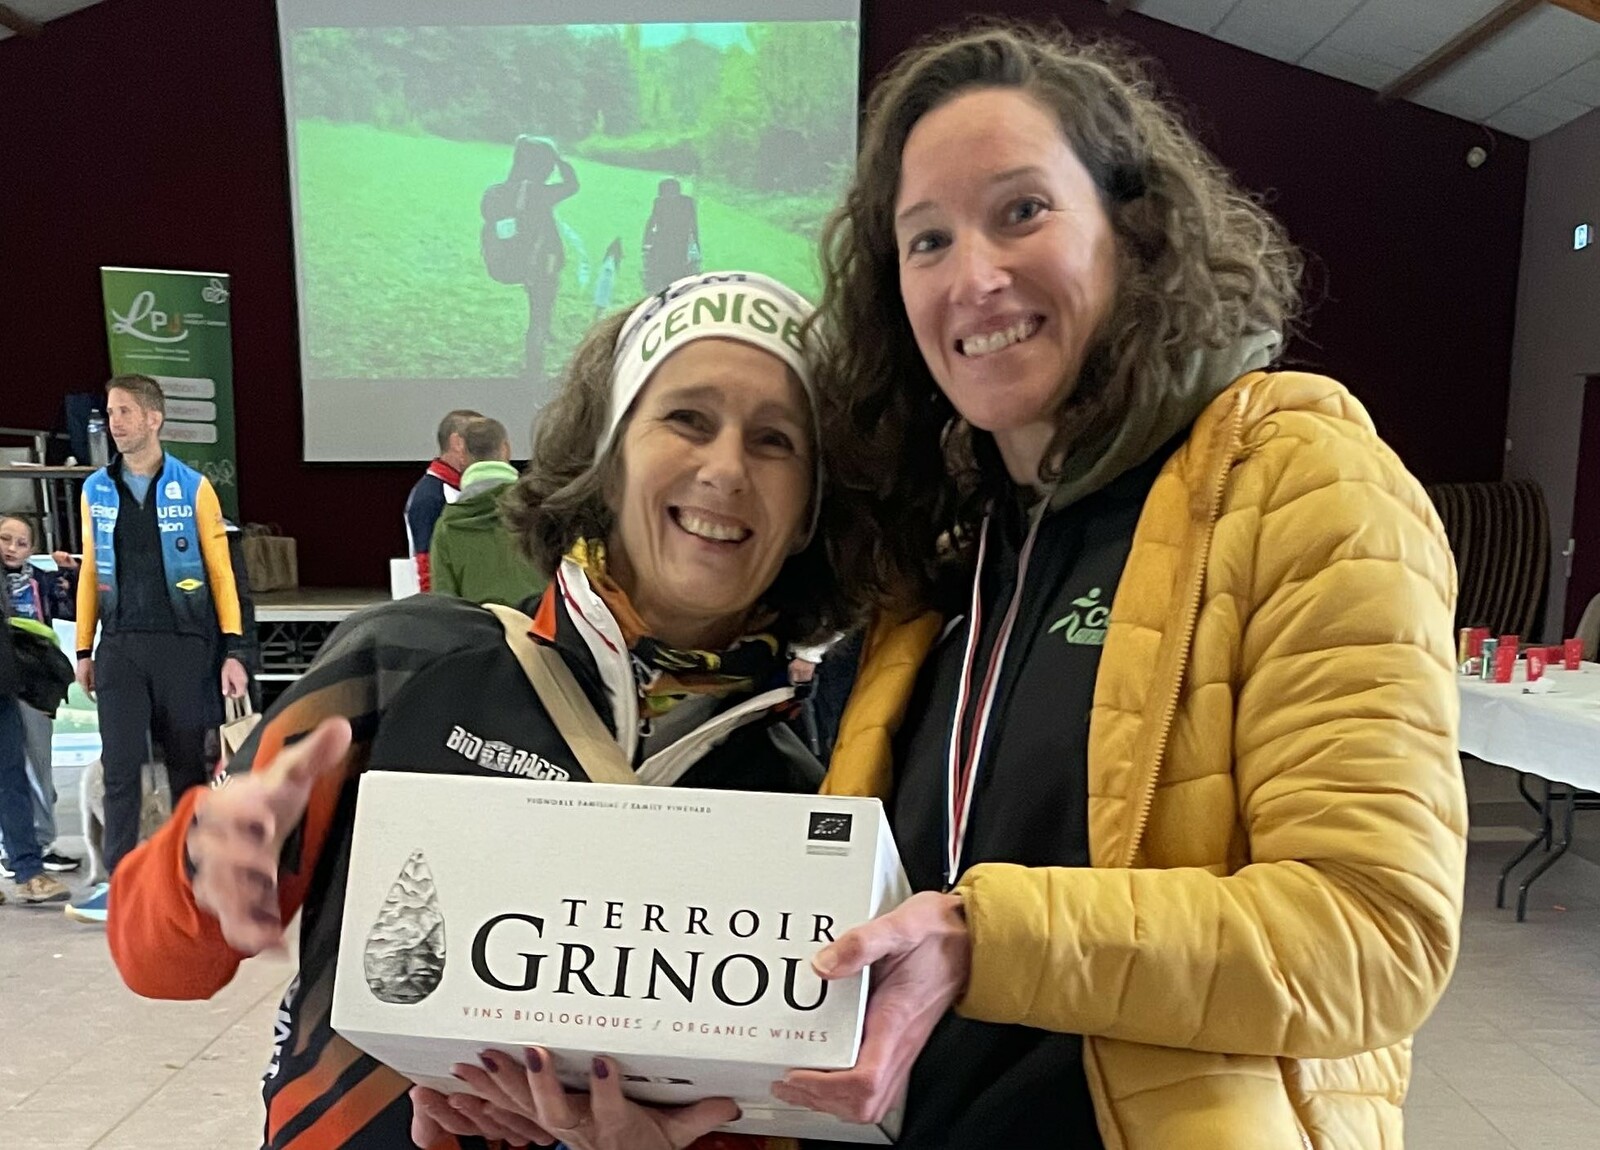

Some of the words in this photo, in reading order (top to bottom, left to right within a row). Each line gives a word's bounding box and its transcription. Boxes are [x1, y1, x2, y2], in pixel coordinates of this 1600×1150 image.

[446, 725, 484, 761] BIO
[562, 898, 836, 943] TERROIR
[470, 913, 832, 1011] GRINOU
[462, 1007, 503, 1020] VINS
[514, 1010, 644, 1030] BIOLOGIQUES
[672, 1021, 759, 1038] ORGANIC
[769, 1028, 829, 1042] WINES
